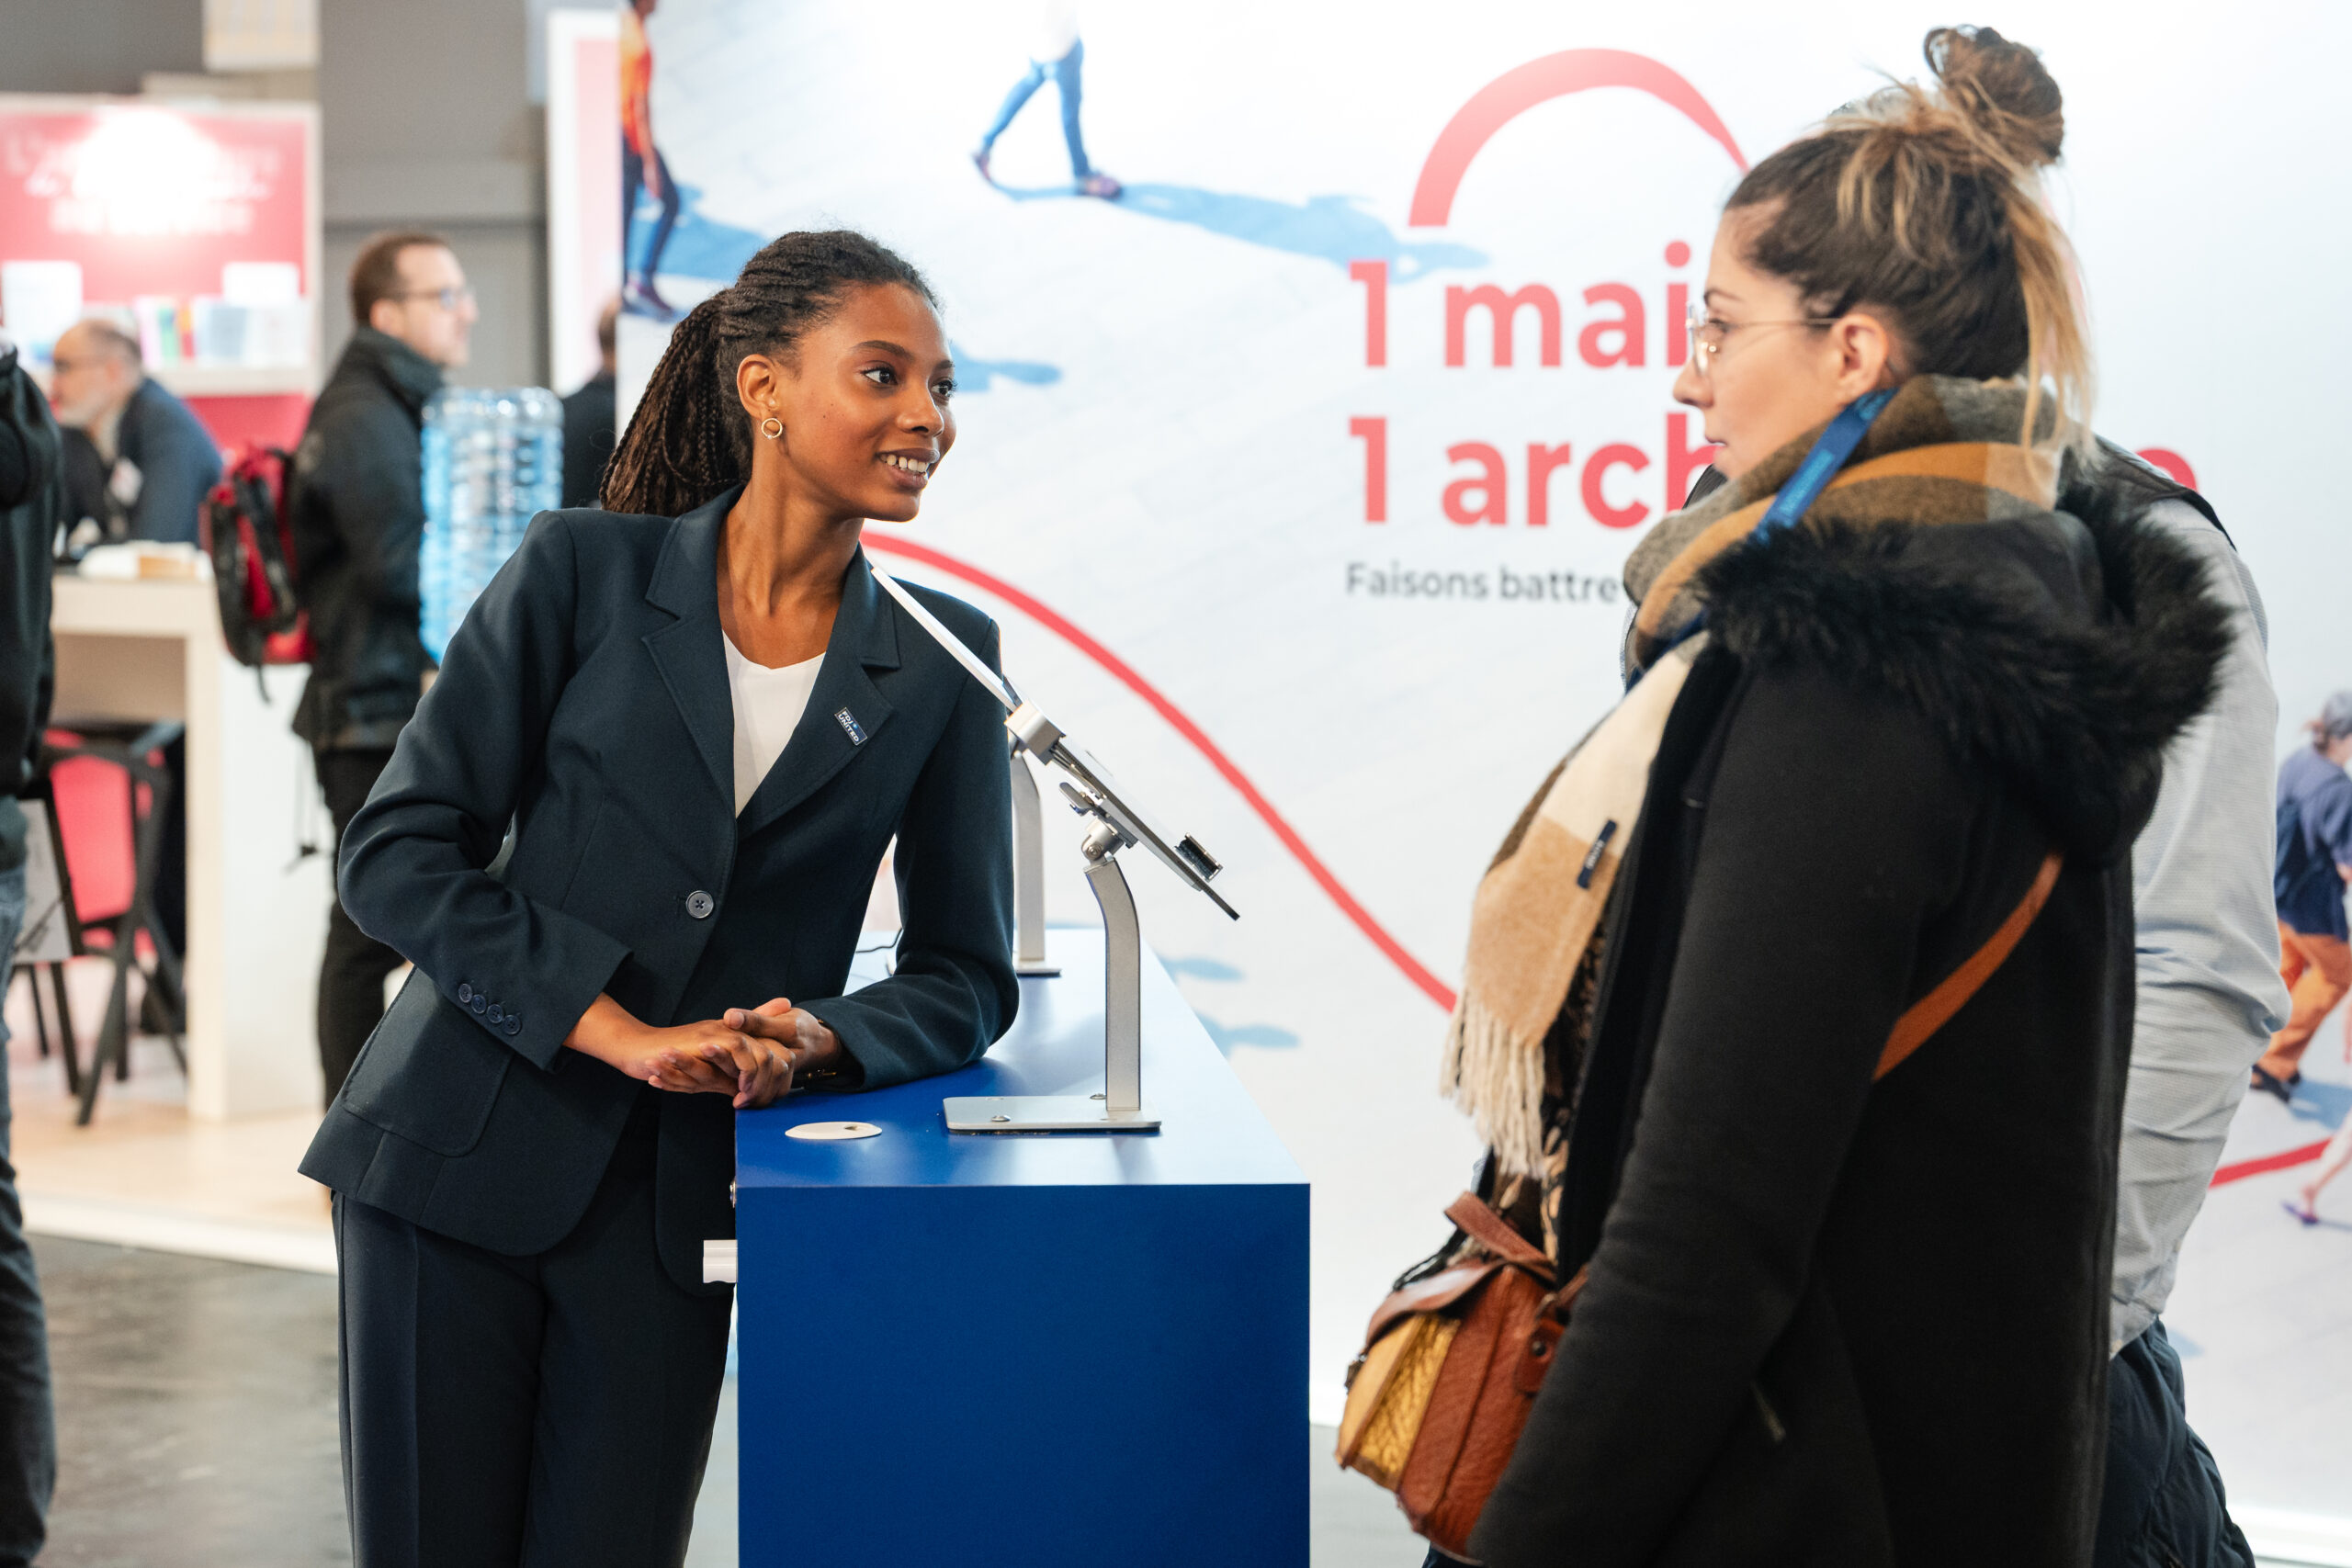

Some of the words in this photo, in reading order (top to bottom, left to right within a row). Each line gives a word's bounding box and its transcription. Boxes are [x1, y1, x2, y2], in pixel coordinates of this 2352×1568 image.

[1348, 259, 1388, 367] 1
[1444, 239, 1690, 368] mai
[1348, 416, 1387, 524] 1
[1441, 412, 1721, 529] arch
[1346, 560, 1489, 599] Faisons
[1499, 566, 1619, 603] battre
[838, 713, 859, 741] UNITED
[842, 711, 854, 725] FDJ
